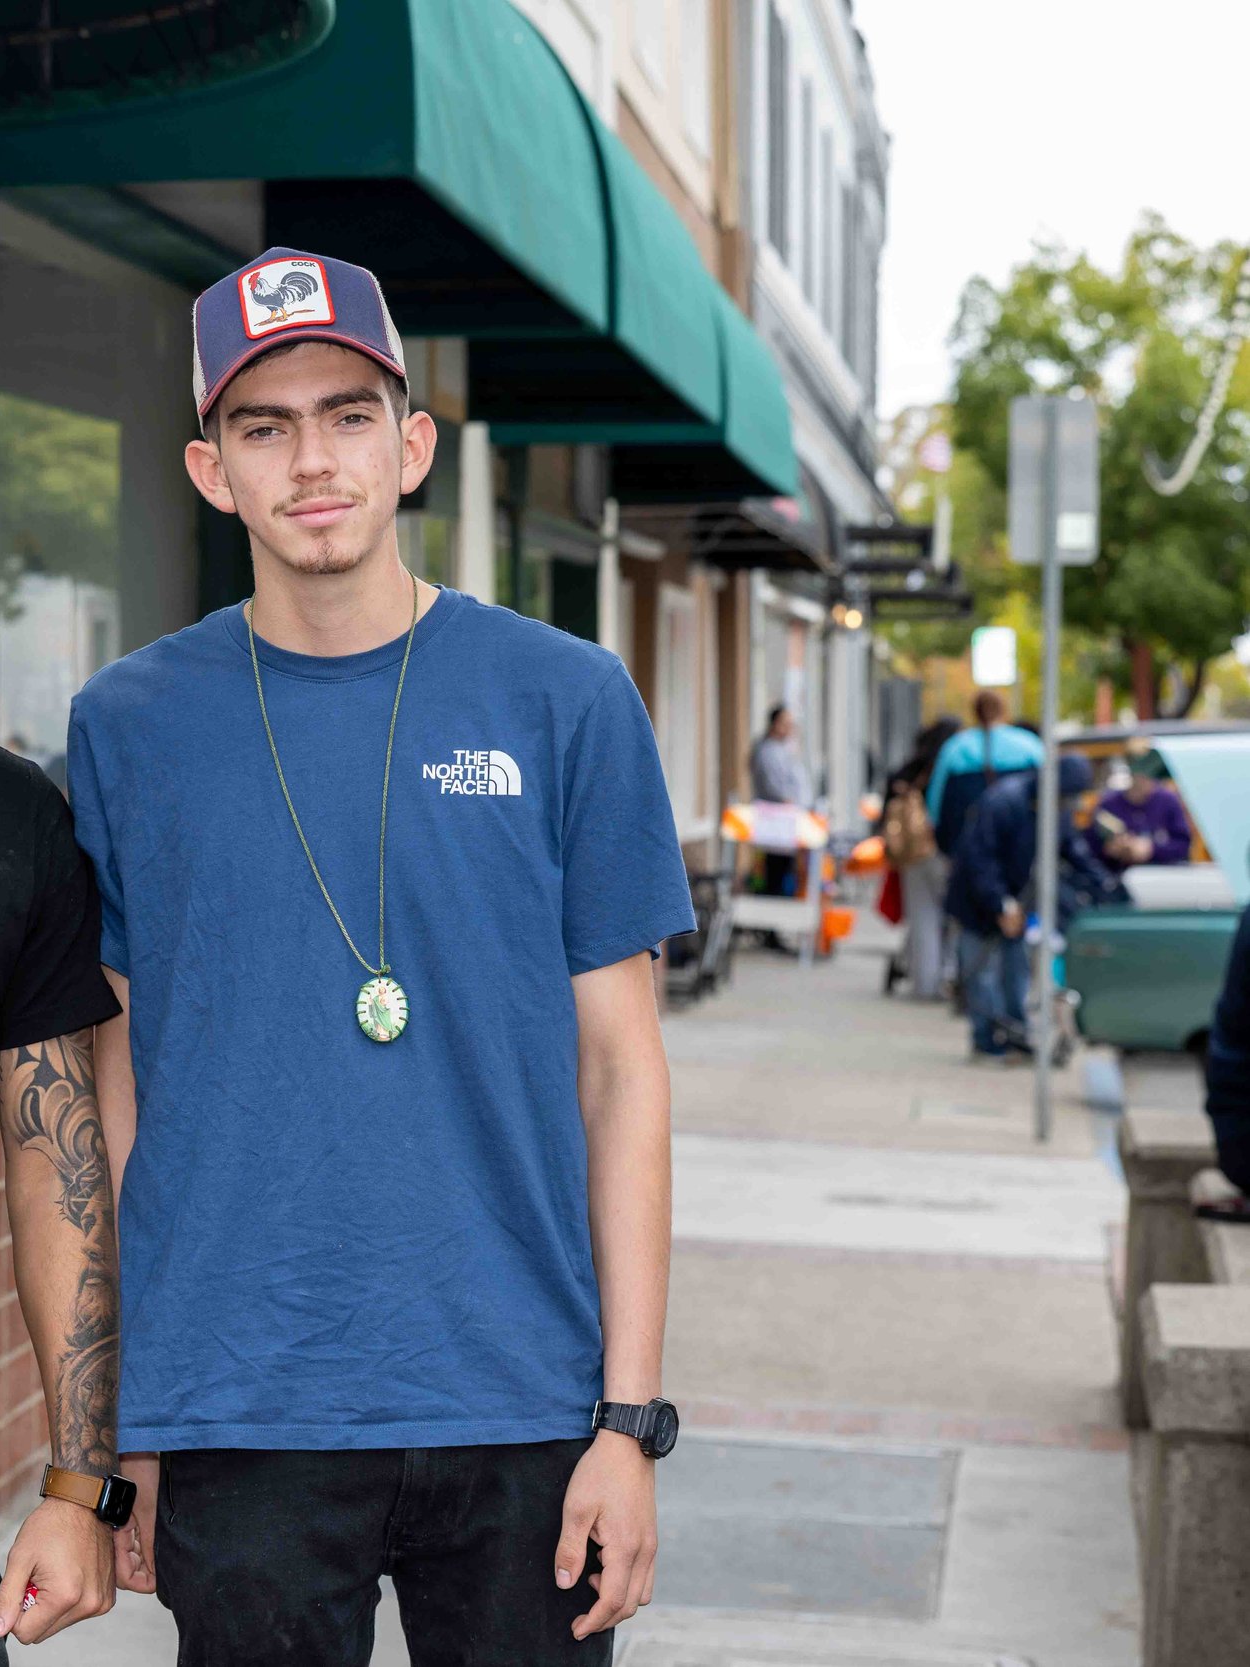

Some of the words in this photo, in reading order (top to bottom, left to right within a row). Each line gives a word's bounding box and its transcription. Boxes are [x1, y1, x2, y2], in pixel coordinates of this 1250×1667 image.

[453, 749, 489, 766] THE
[422, 763, 489, 780] NORTH
[440, 779, 489, 795] FACE
